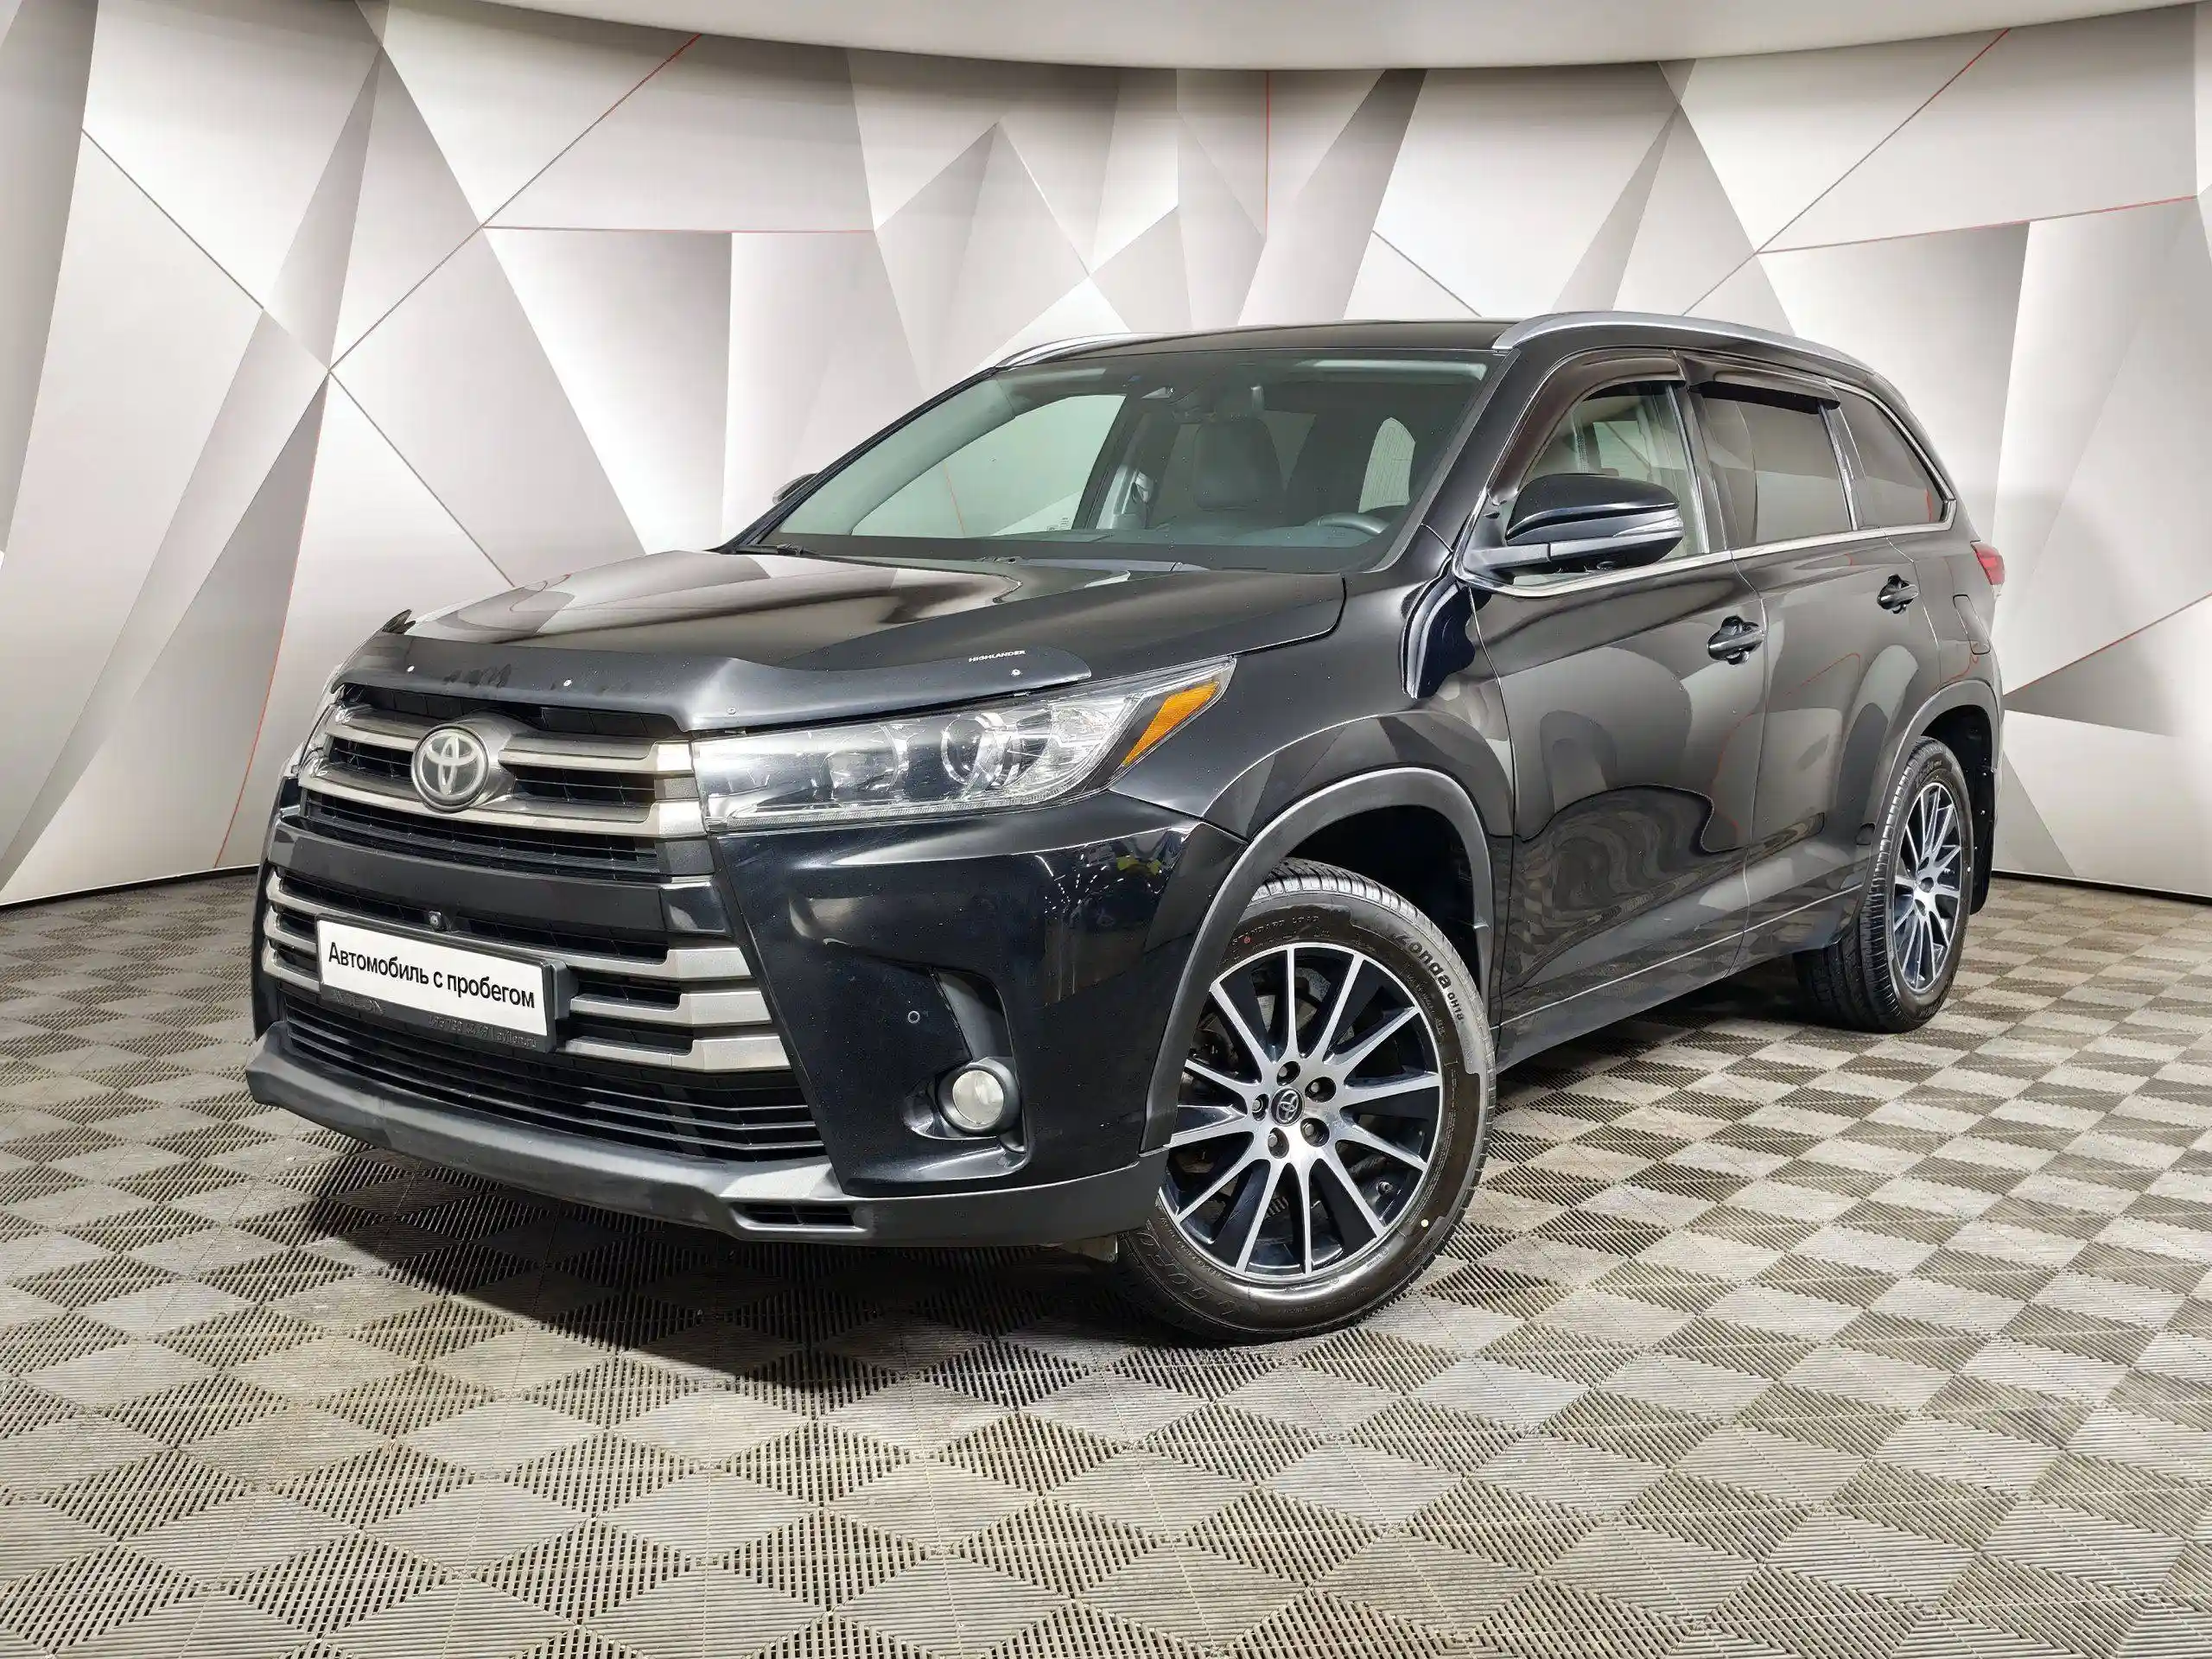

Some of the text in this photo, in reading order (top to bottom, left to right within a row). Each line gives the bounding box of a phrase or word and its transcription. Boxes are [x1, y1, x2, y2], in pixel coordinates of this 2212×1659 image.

[968, 650, 1027, 663] HIGHLANDER
[328, 942, 535, 1008] Автомобиль с пробегом
